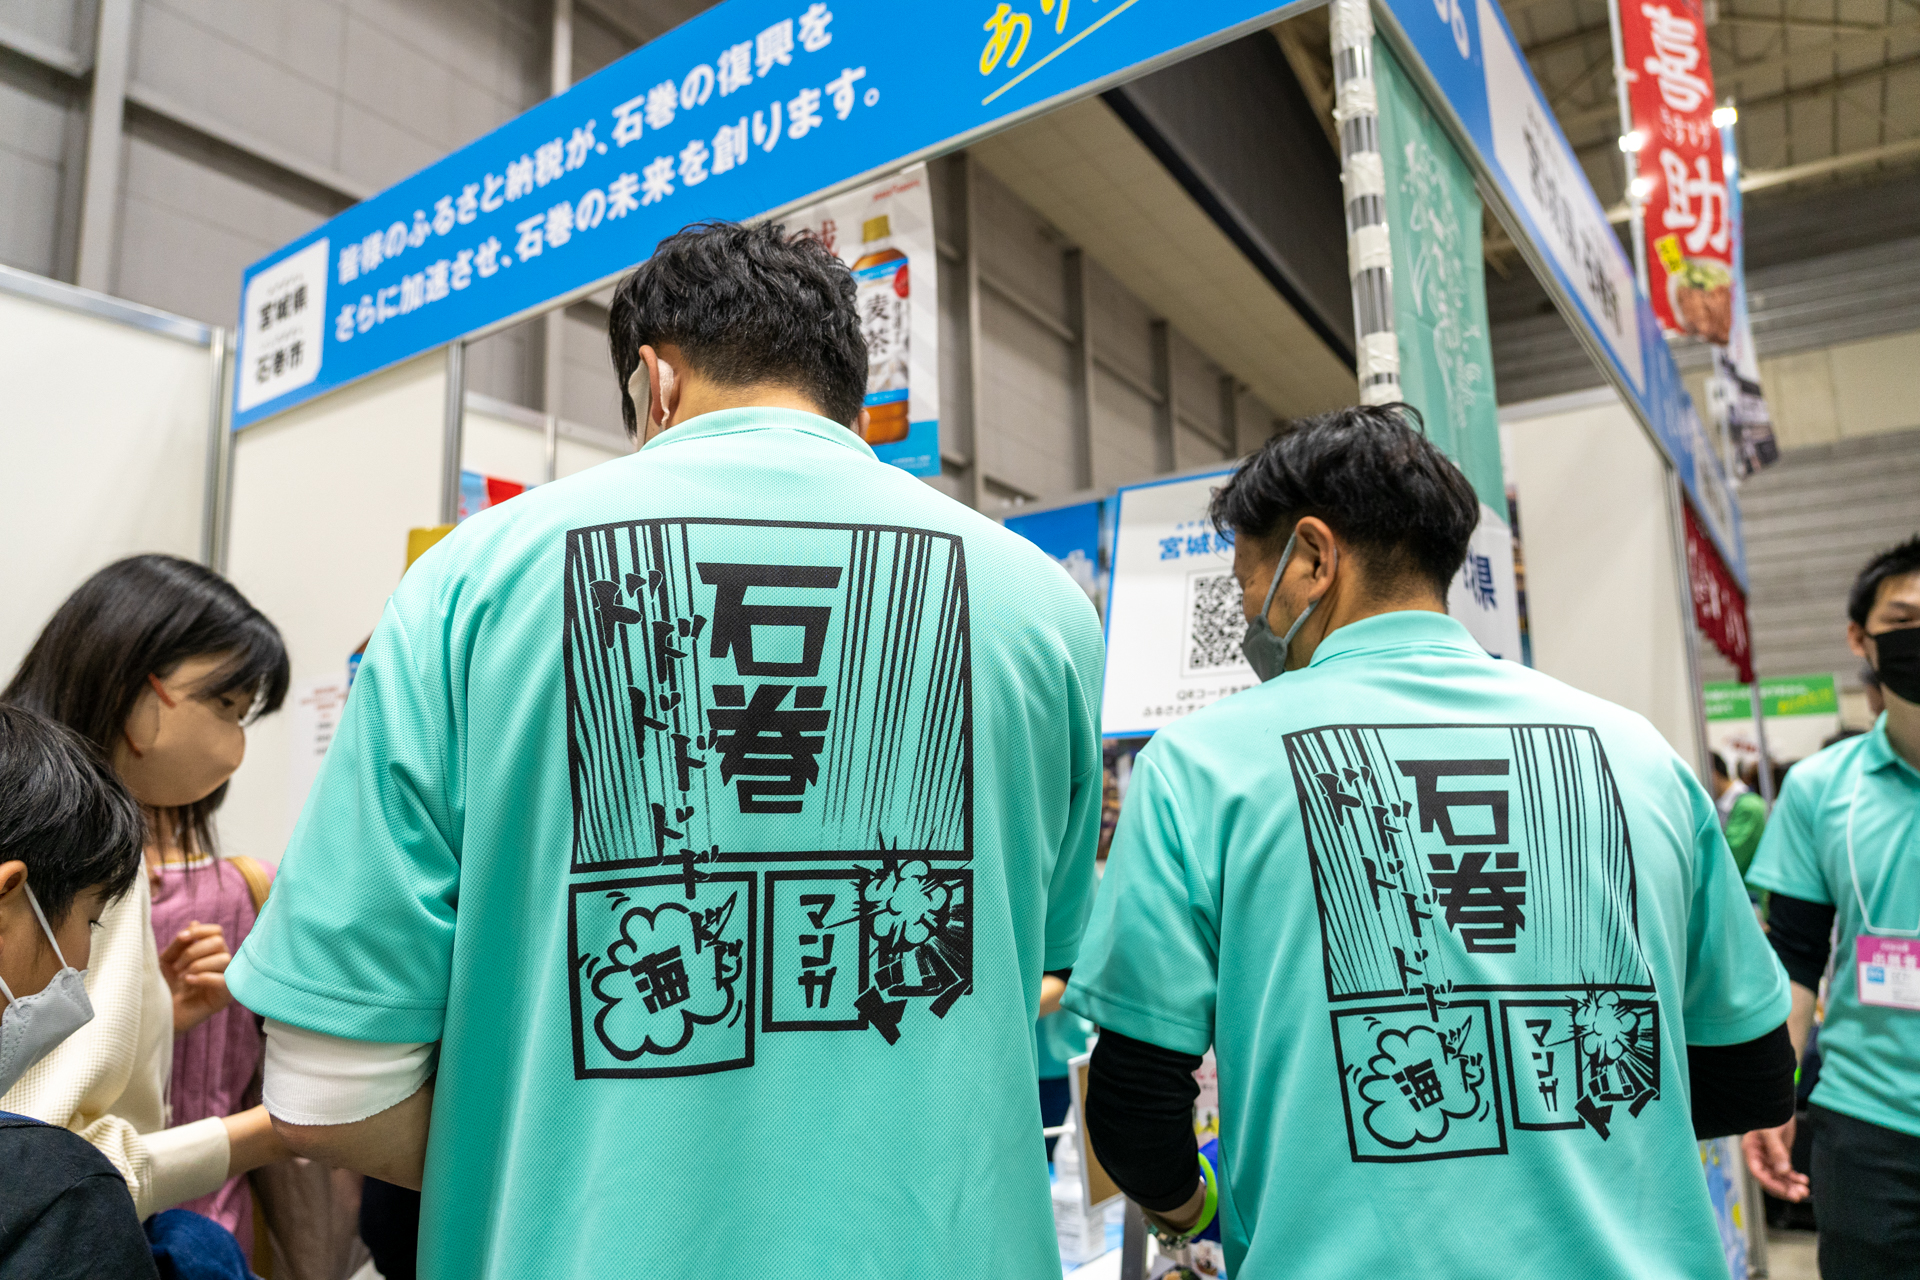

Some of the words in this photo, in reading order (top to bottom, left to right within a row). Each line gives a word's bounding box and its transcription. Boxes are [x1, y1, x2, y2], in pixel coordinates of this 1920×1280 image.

[334, 65, 881, 343] さらに加速させ、石巻の未来を創ります。
[337, 1, 834, 285] 皆様のふるさと納税が、石巻の復興を
[695, 561, 843, 814] 石巻
[798, 893, 838, 1010] マンガ
[1394, 758, 1527, 954] 石巻
[1524, 1018, 1559, 1113] マンガ
